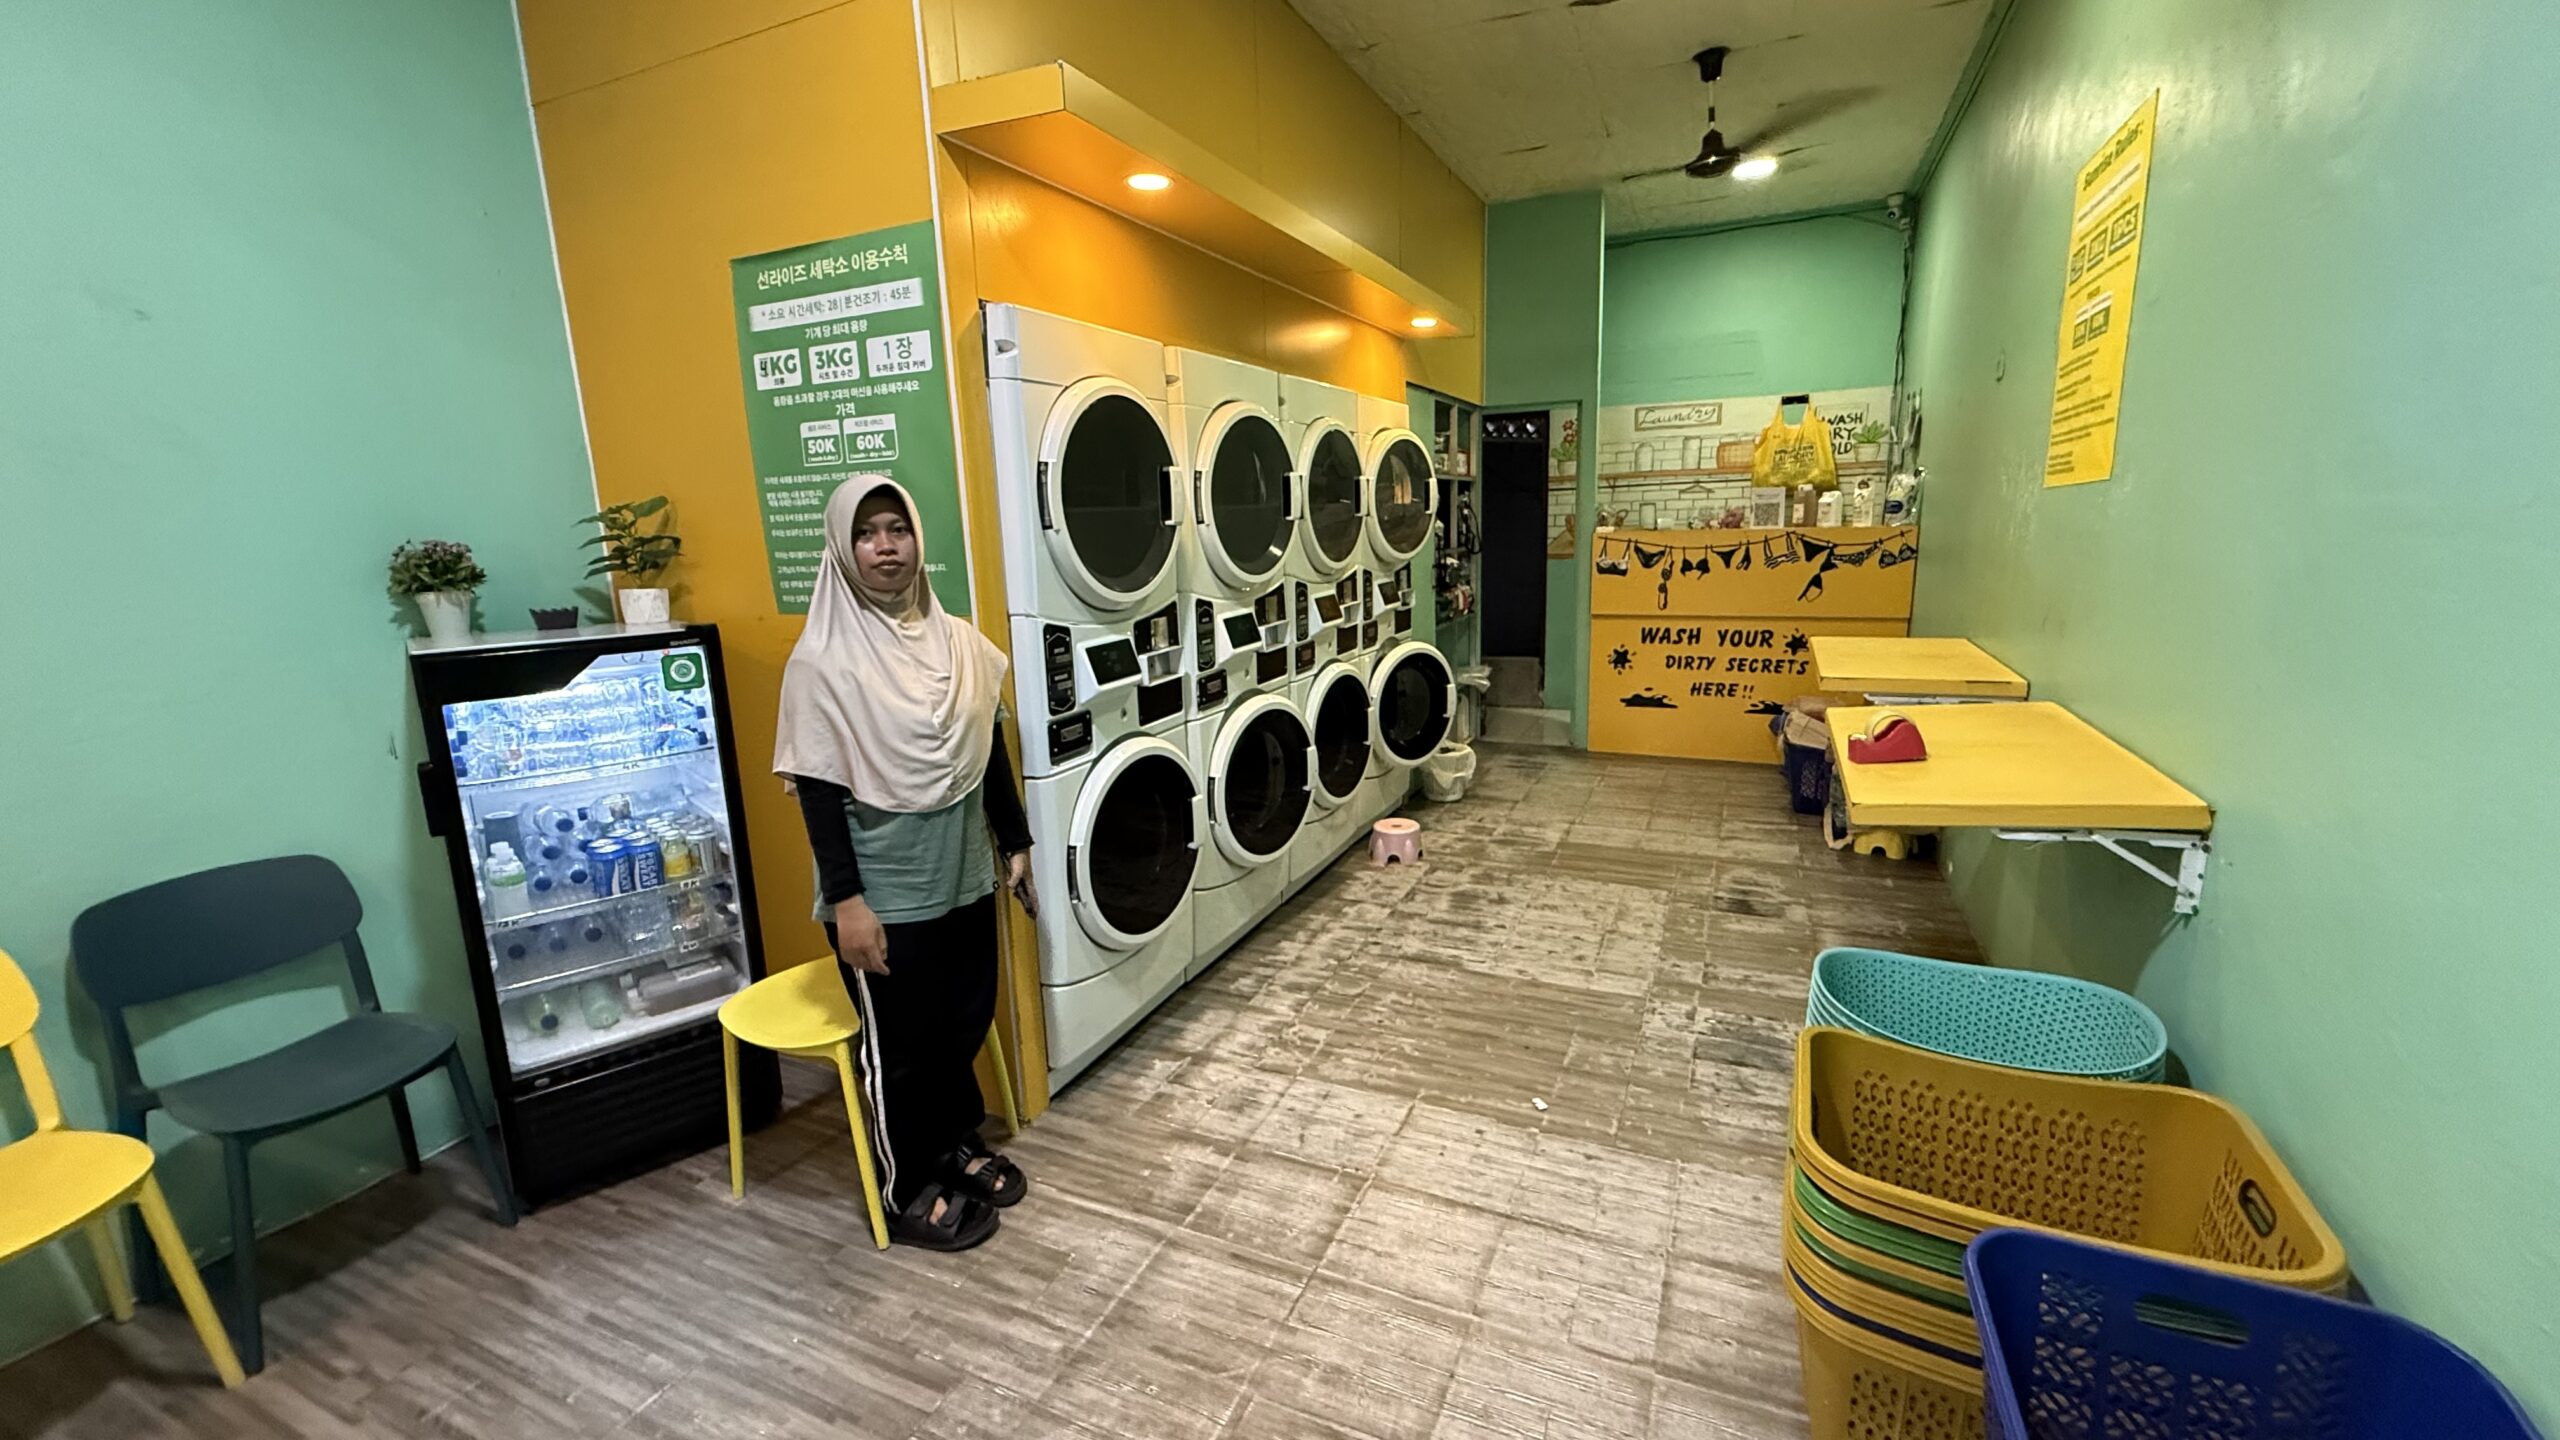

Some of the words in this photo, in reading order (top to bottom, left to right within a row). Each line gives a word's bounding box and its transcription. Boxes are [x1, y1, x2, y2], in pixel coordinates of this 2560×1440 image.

[757, 263, 808, 290] 선라이즈
[809, 256, 850, 281] 세탁소
[852, 243, 909, 272] 이용수칙
[814, 347, 853, 370] 3KG
[895, 336, 913, 360] 장
[835, 402, 856, 417] 가격
[1639, 405, 1717, 427] Laundry
[856, 433, 886, 450] 60K
[1829, 426, 1857, 440] RY
[807, 438, 837, 455] 50K
[1641, 626, 1702, 646] WASH
[1717, 628, 1775, 649] YOUR
[1665, 654, 1717, 671] DIRTY
[1725, 656, 1810, 676] SECRETS
